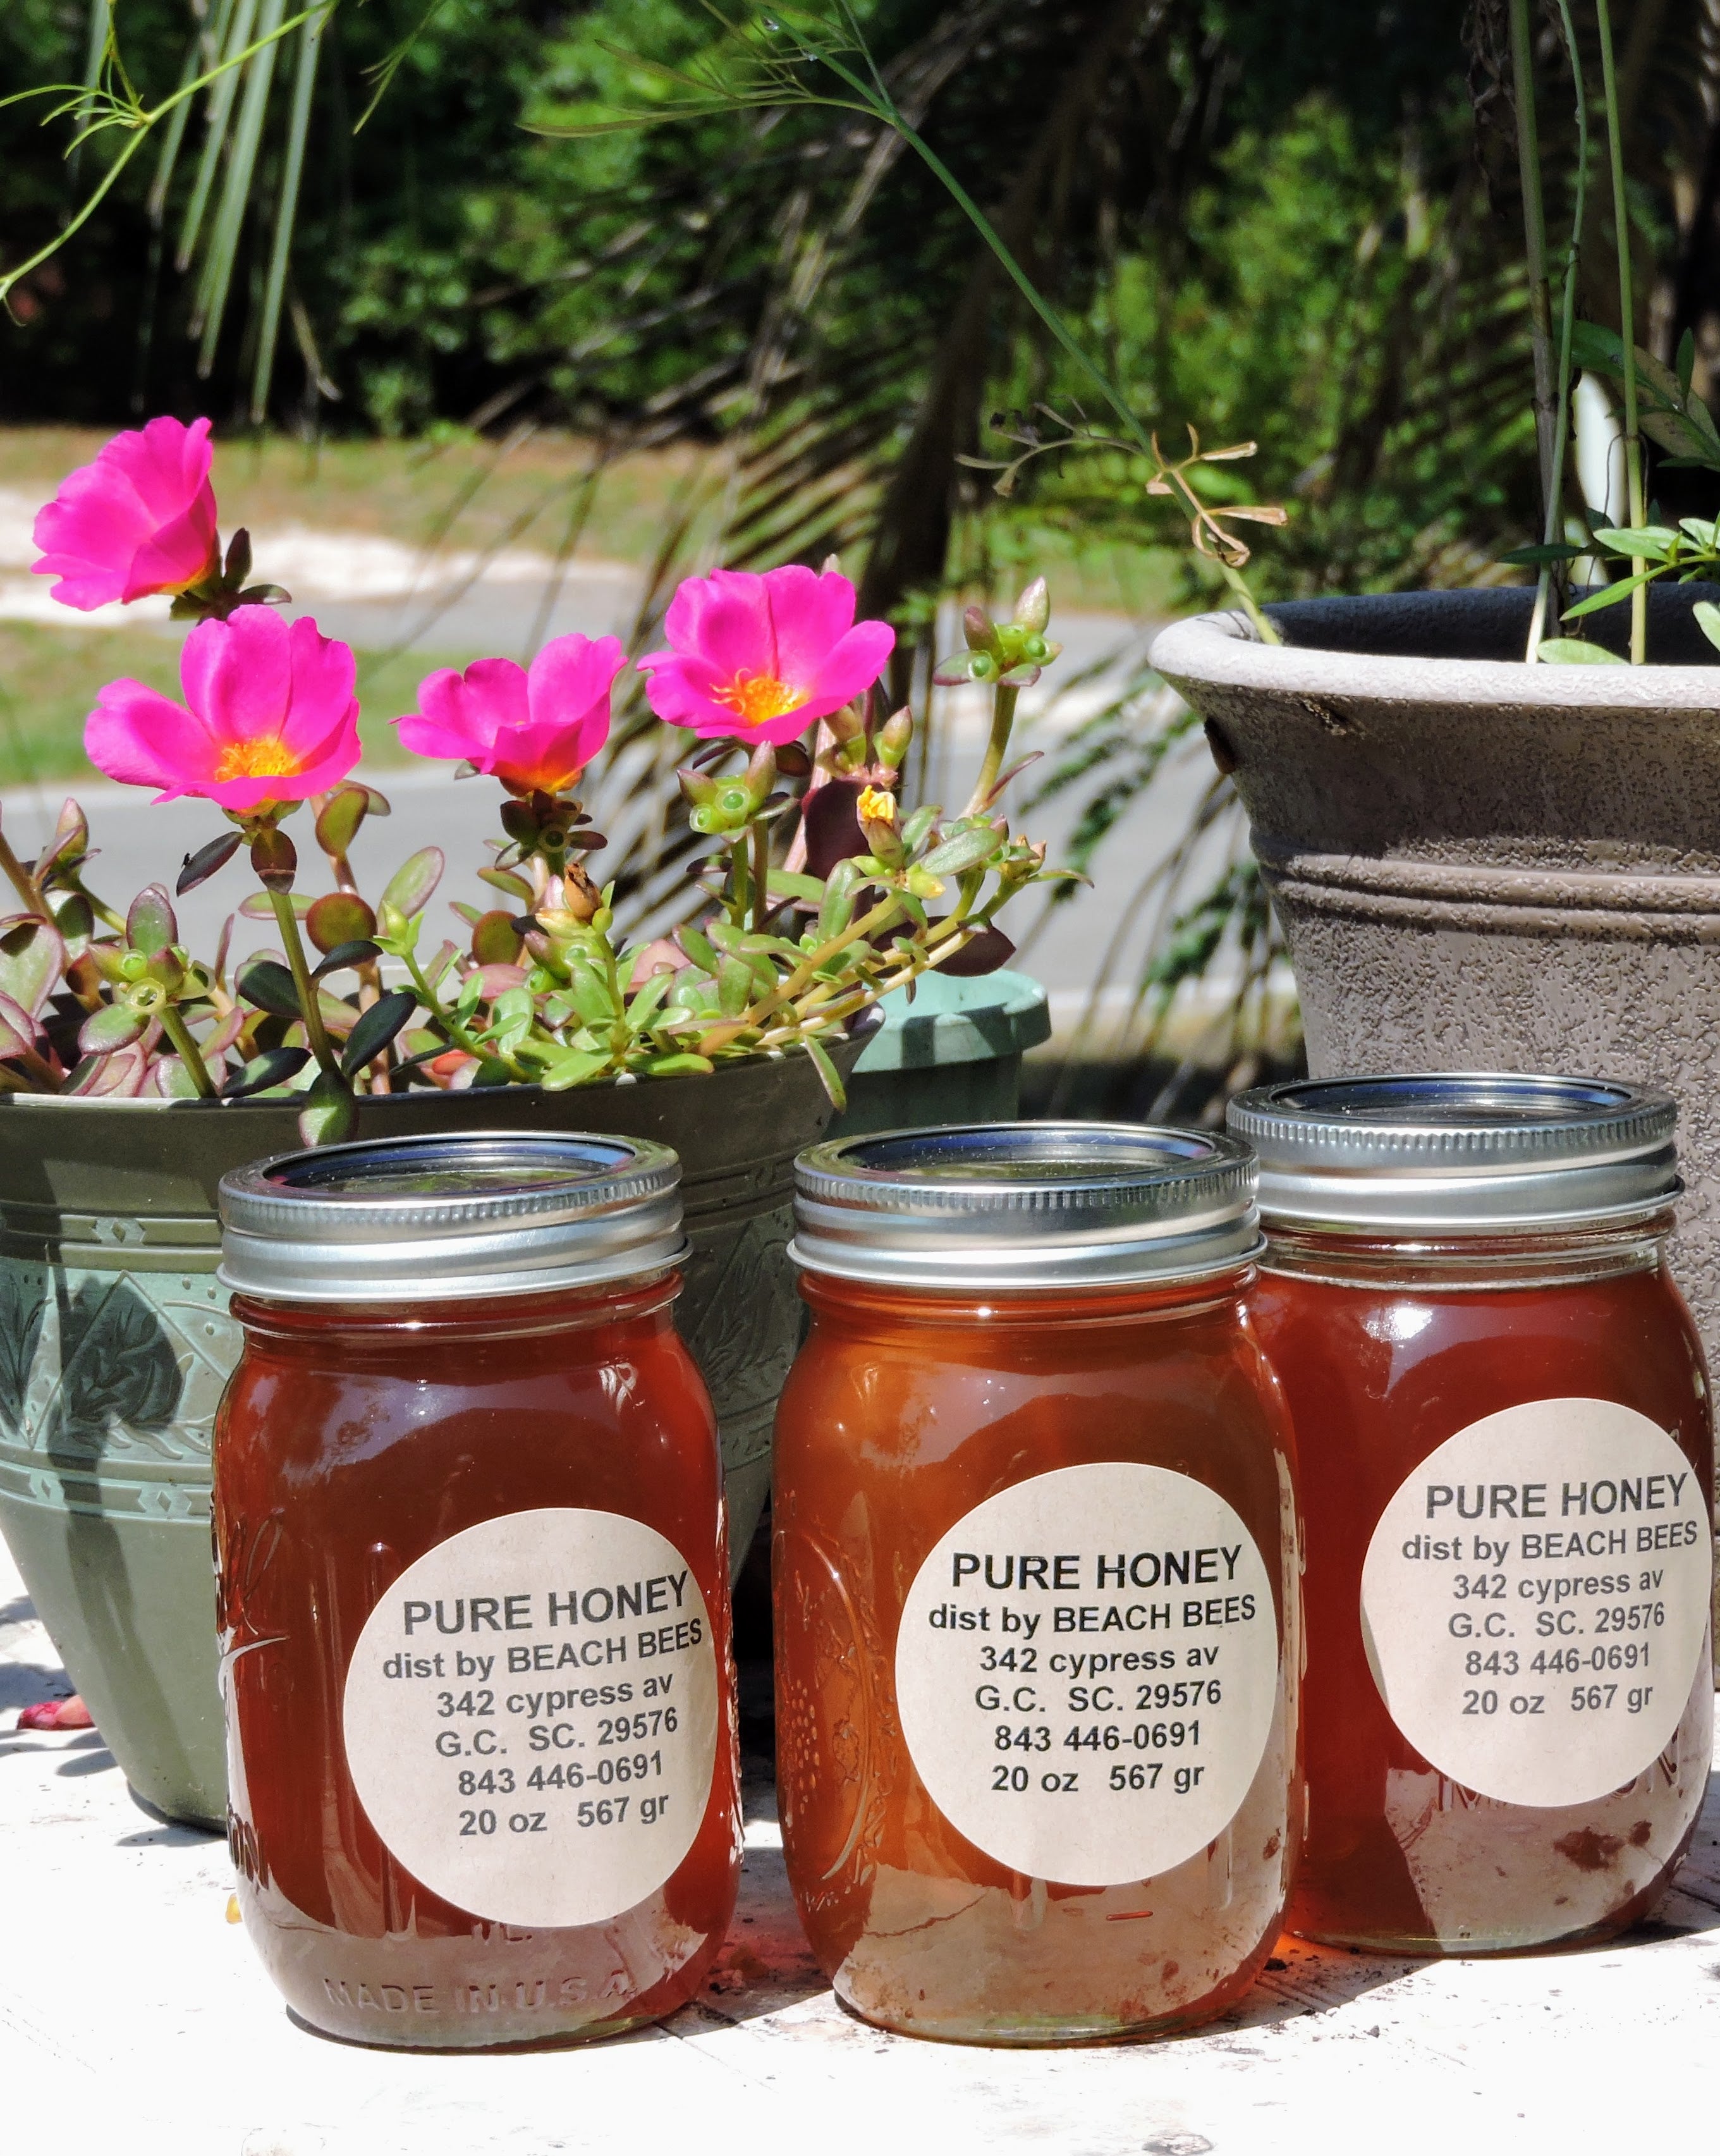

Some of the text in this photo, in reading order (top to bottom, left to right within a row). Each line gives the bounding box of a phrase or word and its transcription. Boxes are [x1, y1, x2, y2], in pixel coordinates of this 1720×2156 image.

[1426, 1471, 1688, 1519] PURE HONEY
[1401, 1520, 1697, 1567] dist by BEACH BEES
[952, 1544, 1243, 1591] PURE HONEY
[1453, 1569, 1664, 1605] 342 cypress av
[403, 1570, 688, 1636] PURE HONEY
[928, 1593, 1256, 1641] dist by BEACH BEES
[1448, 1601, 1664, 1638] G.C. SC. 29576
[382, 1617, 703, 1682] dist by BEACH BEES
[979, 1645, 1219, 1680] 342 cypress av
[1465, 1641, 1649, 1676] 843 446-0691
[437, 1673, 673, 1720] 342 cypress av
[975, 1679, 1222, 1713] G.C. SC. 29576
[1462, 1684, 1654, 1715] 20 oz 567 gr
[435, 1706, 678, 1758] G.C. SC. 29576
[994, 1719, 1200, 1753] 843 446-0691
[458, 1749, 662, 1796] 843 446-0691
[991, 1762, 1205, 1794] 20 oz 567 gr
[459, 1794, 669, 1836] 20 oz 567 gr
[323, 1977, 441, 2014] MADE
[454, 1983, 501, 2014] IN
